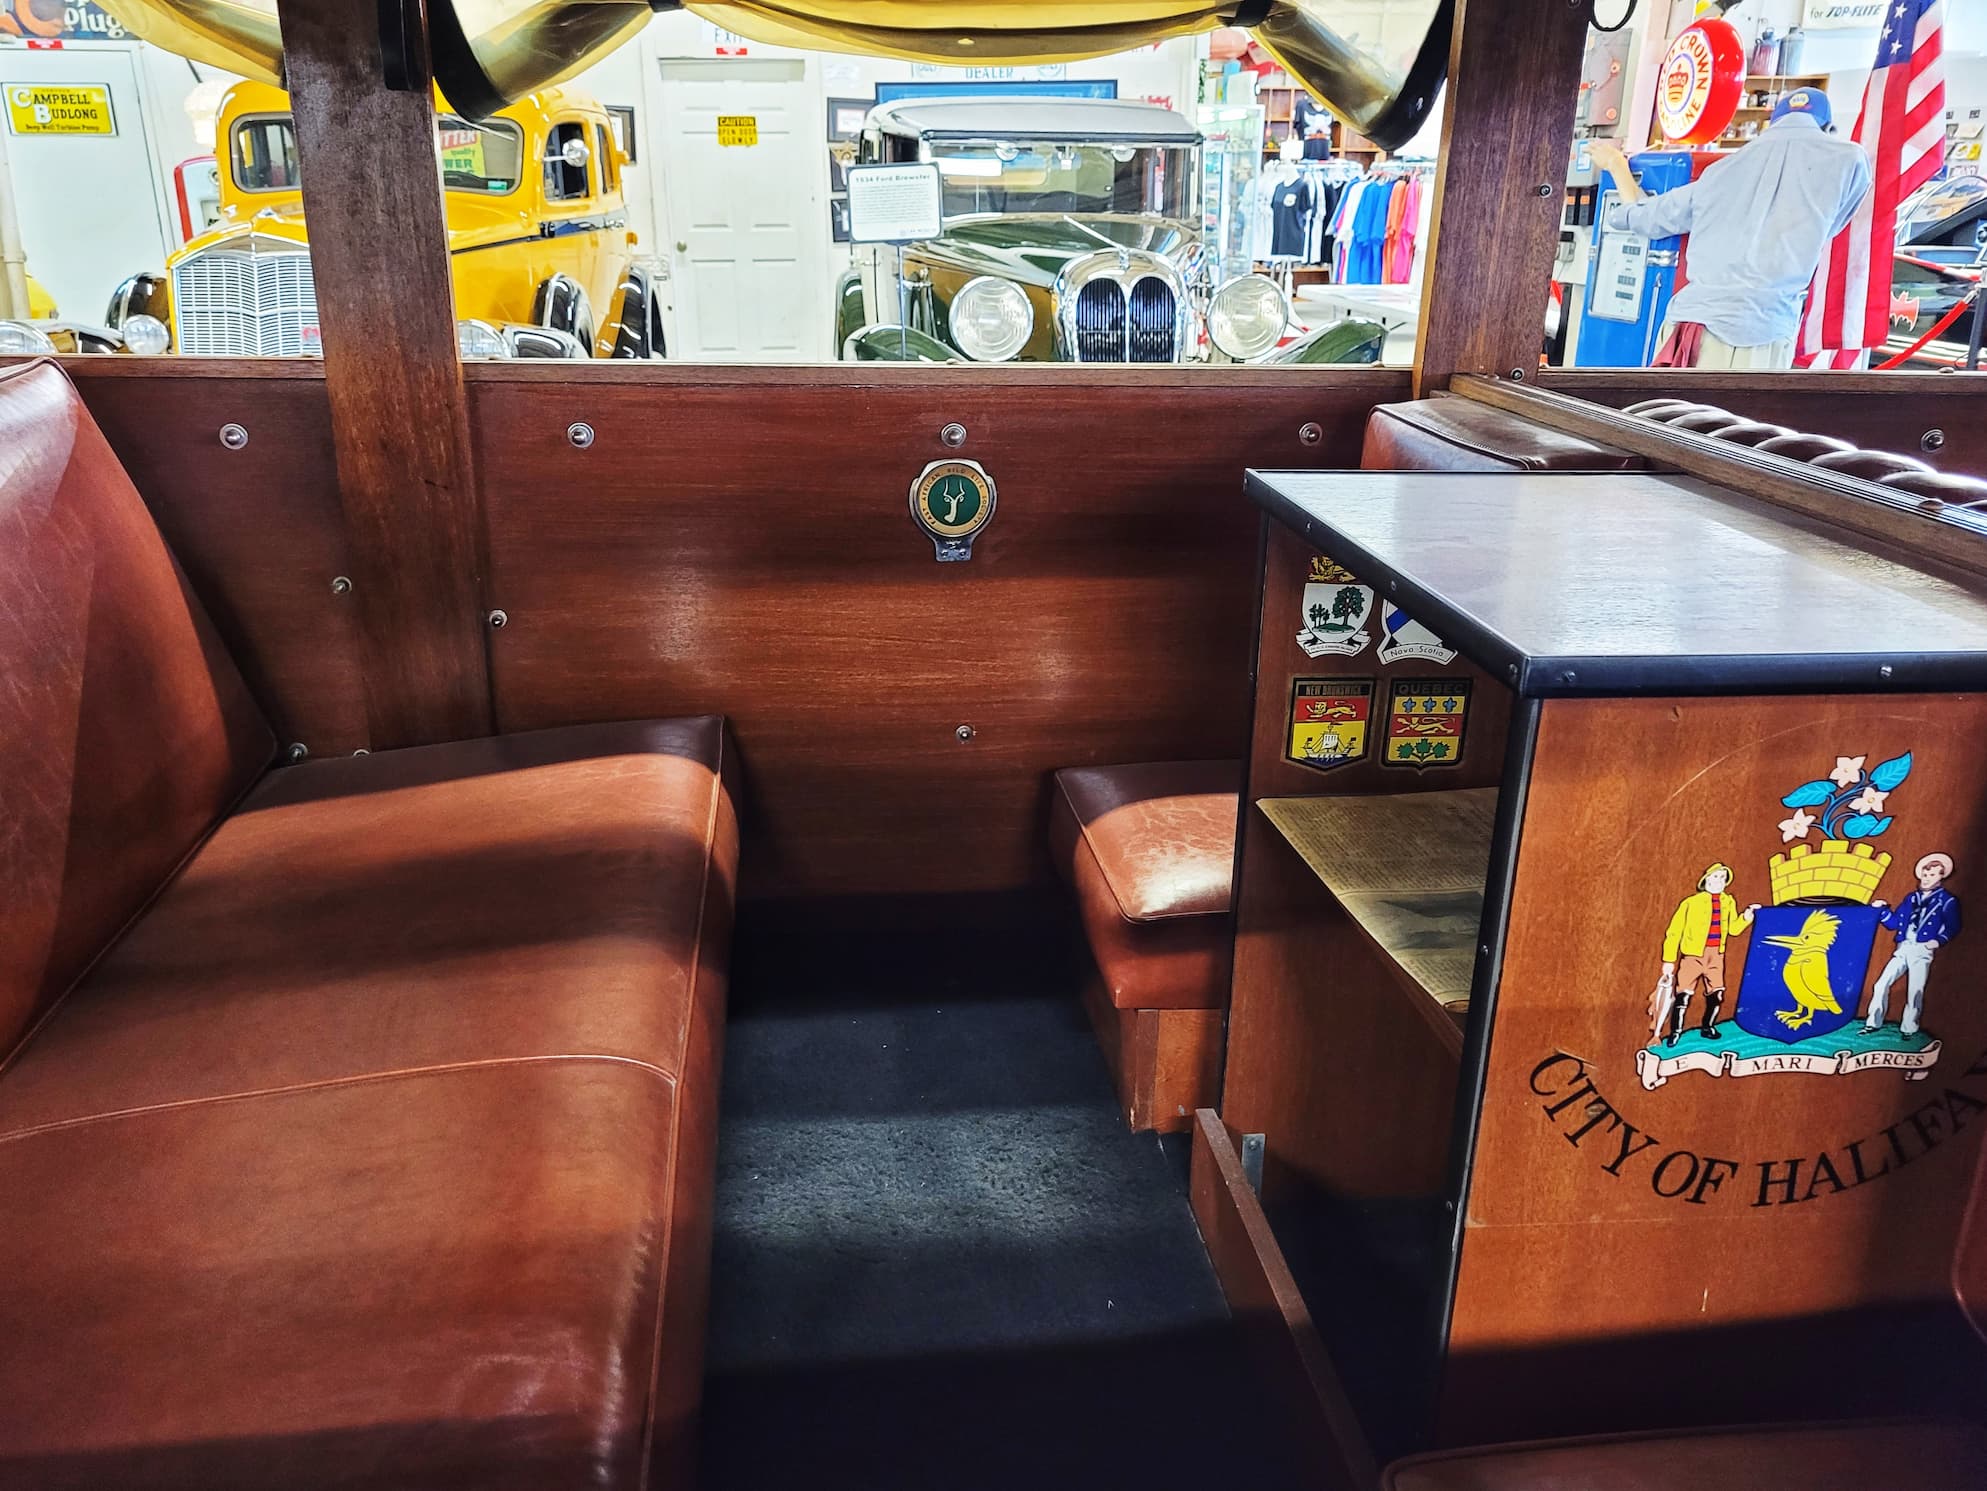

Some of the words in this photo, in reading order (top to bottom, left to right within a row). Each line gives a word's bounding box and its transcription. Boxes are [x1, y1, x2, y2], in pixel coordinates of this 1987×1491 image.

[1809, 7, 1823, 19] for
[64, 7, 128, 39] Plug
[1679, 34, 1710, 90] CROWN
[965, 66, 1014, 80] DEALER
[12, 87, 91, 108] CAMPBELL
[34, 104, 98, 124] BUDLONG
[719, 116, 755, 126] CAUTION
[443, 158, 473, 169] WER
[921, 472, 941, 502] AFRICAN
[1390, 646, 1413, 658] Nova
[1418, 644, 1445, 658] Scotia
[1305, 684, 1321, 696] NEW
[1322, 684, 1361, 696] BRUNSWICK
[1399, 682, 1464, 695] QUEBEC
[1674, 1057, 1690, 1071] E
[1751, 1056, 1814, 1072] MARI
[1853, 1052, 1925, 1068] MERCES
[1529, 1050, 1660, 1178] CITY
[1651, 1150, 1738, 1205] OF
